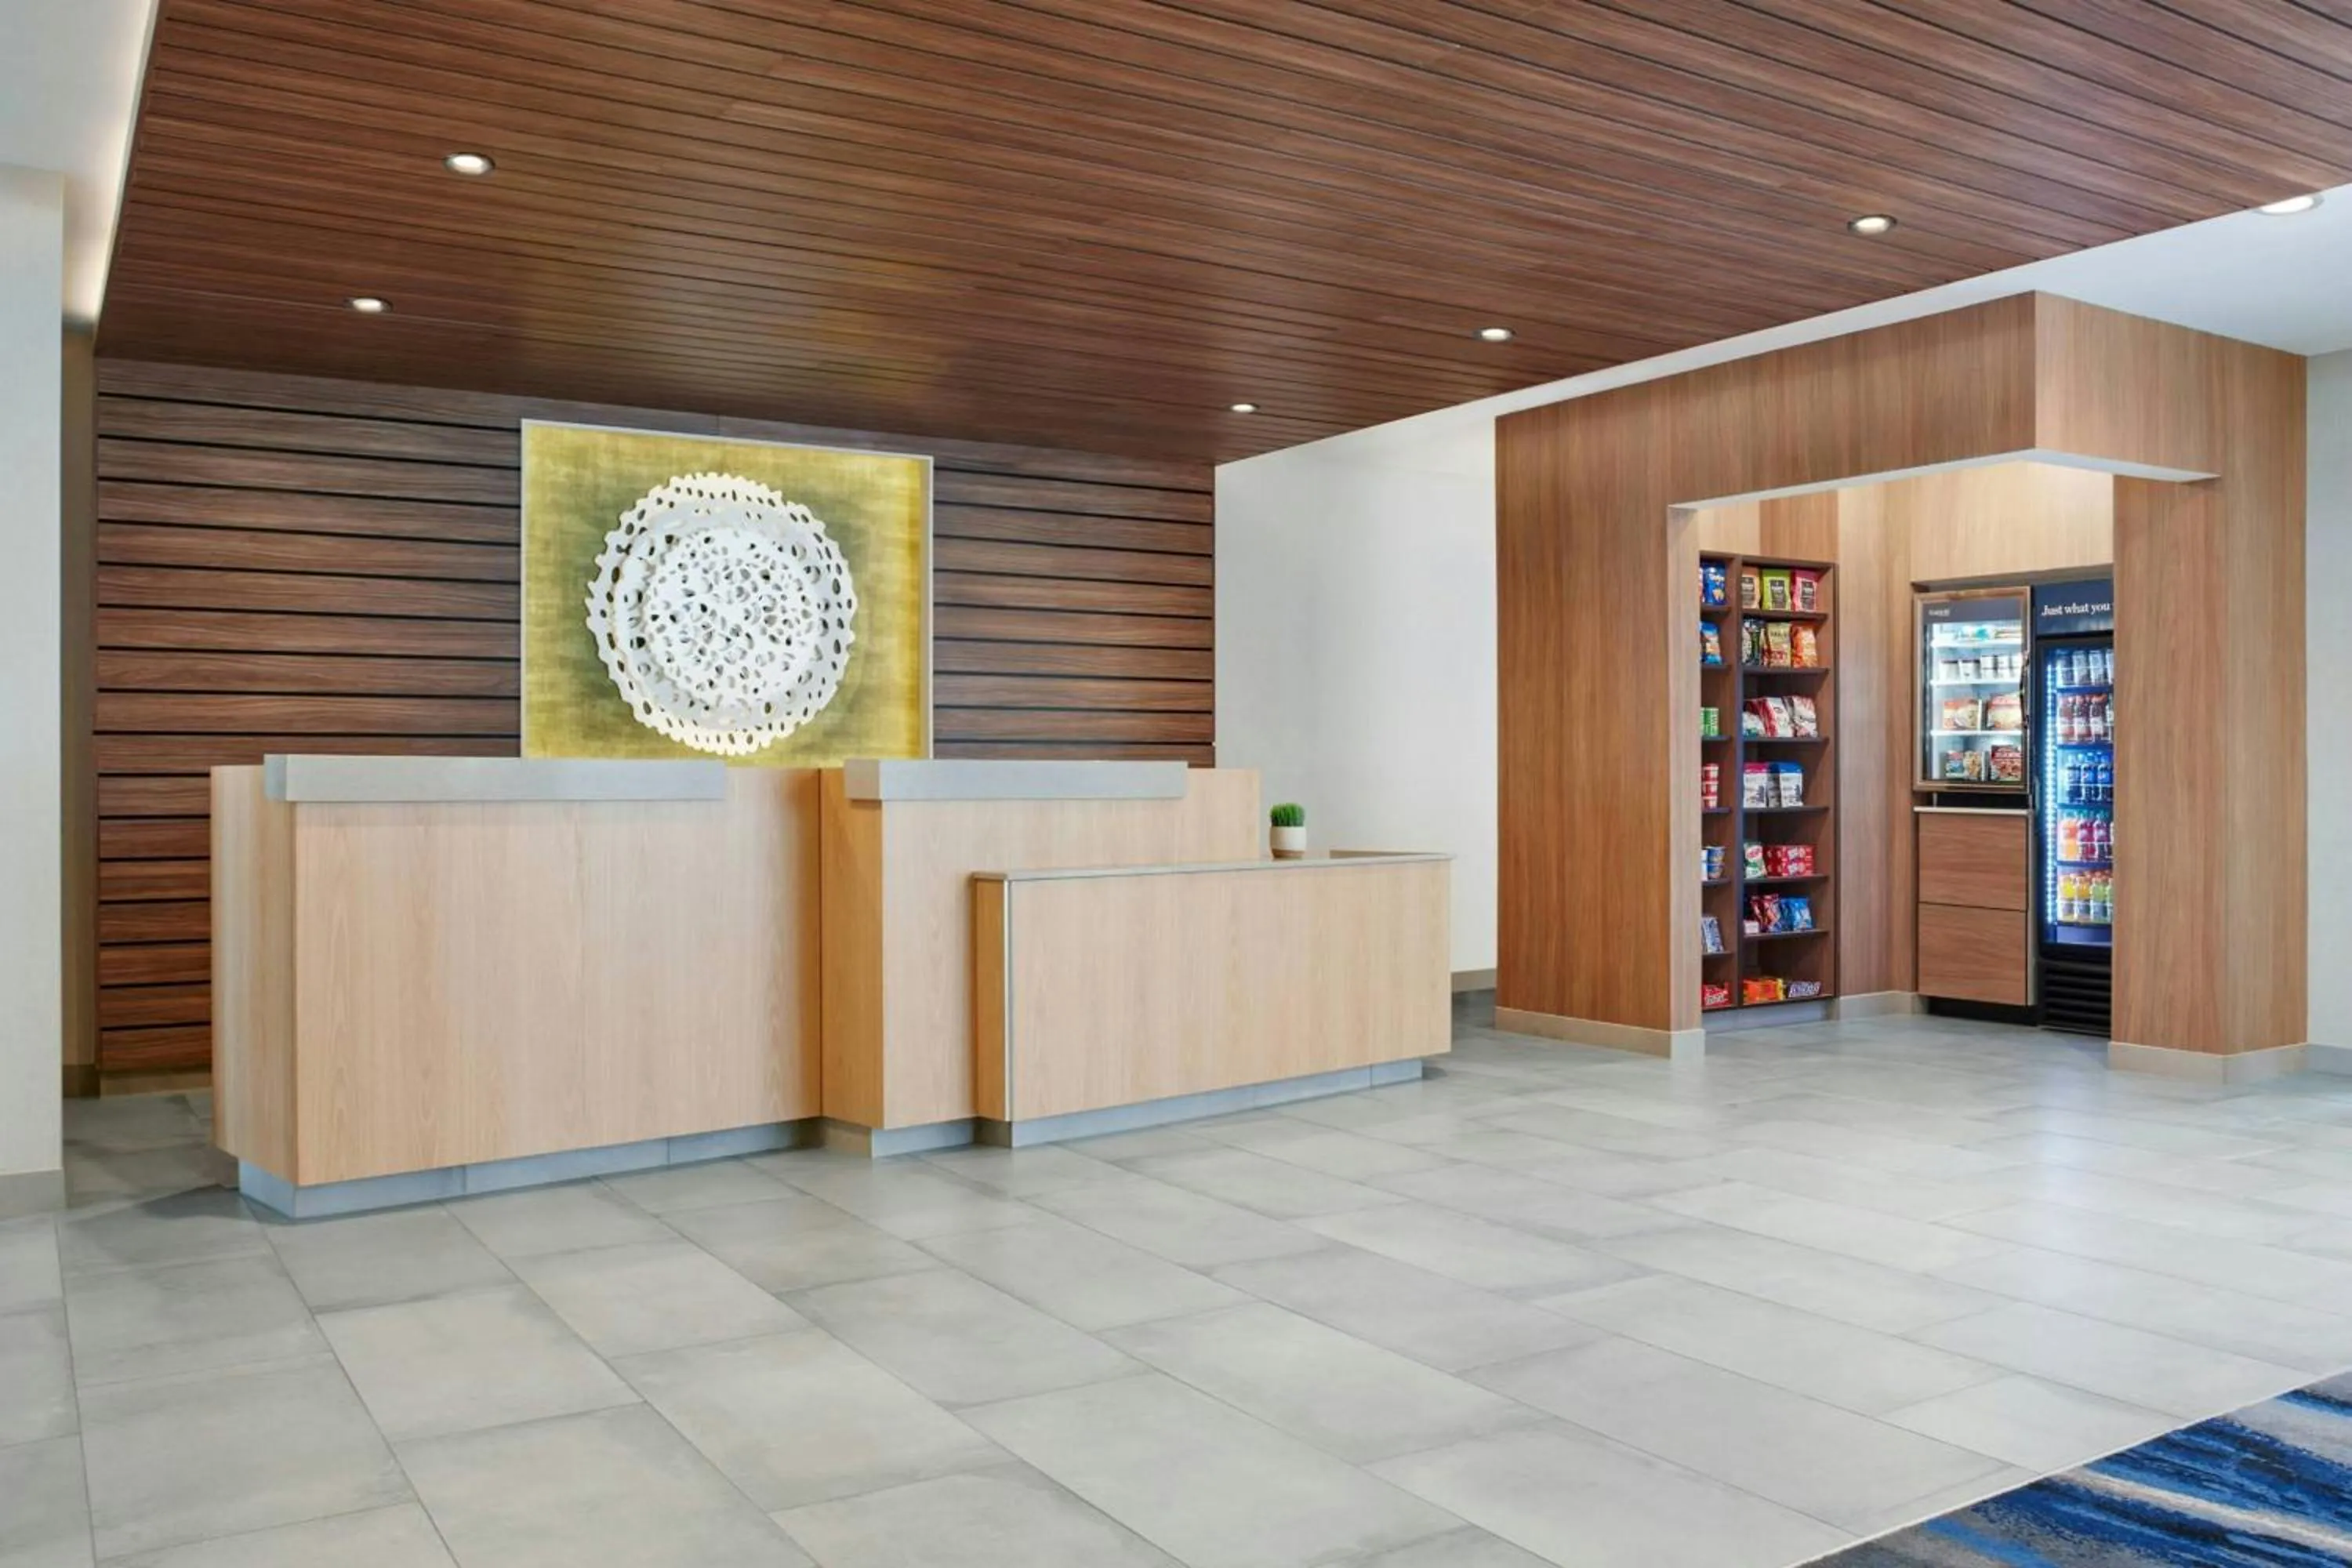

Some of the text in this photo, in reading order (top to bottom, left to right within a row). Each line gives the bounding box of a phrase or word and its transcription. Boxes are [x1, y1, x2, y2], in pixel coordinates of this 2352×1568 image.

[2042, 602, 2111, 616] Just what you
